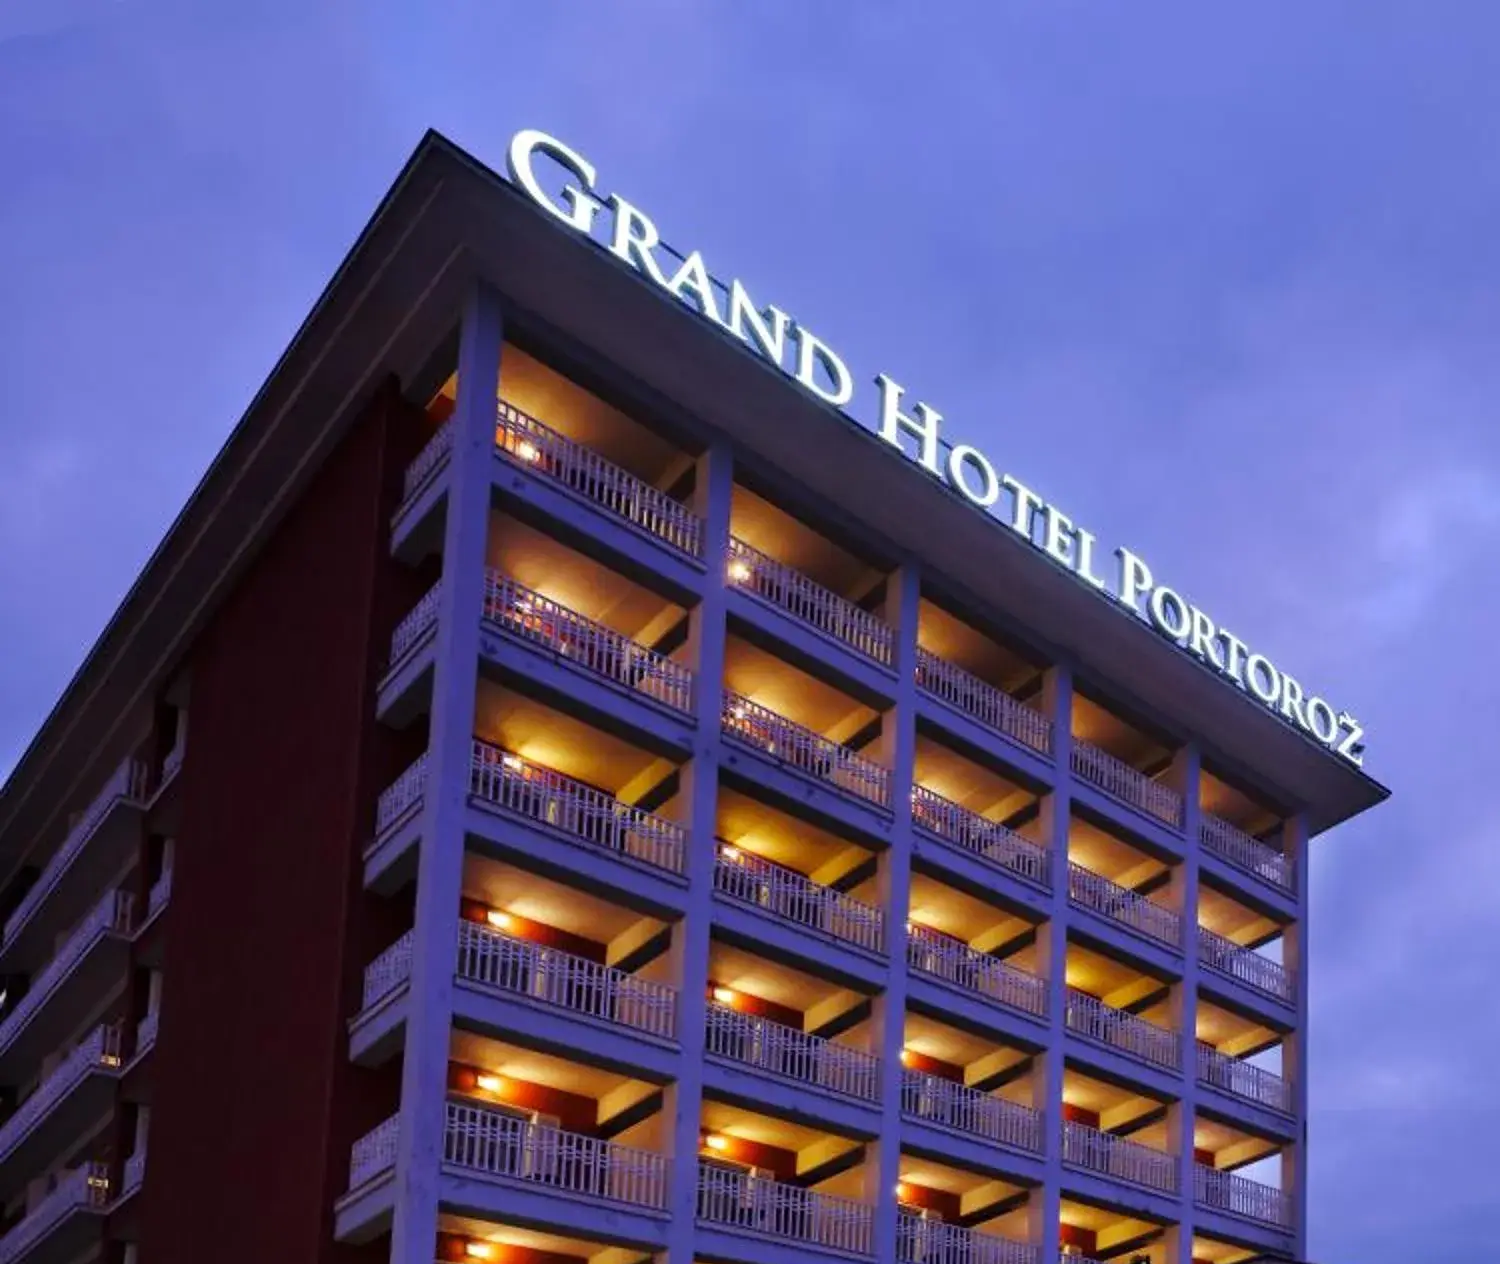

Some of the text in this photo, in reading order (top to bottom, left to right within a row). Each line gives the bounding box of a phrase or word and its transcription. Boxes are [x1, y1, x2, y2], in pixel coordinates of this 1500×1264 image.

[509, 129, 1364, 767] GRAND HOTEL PORTOROŽ
